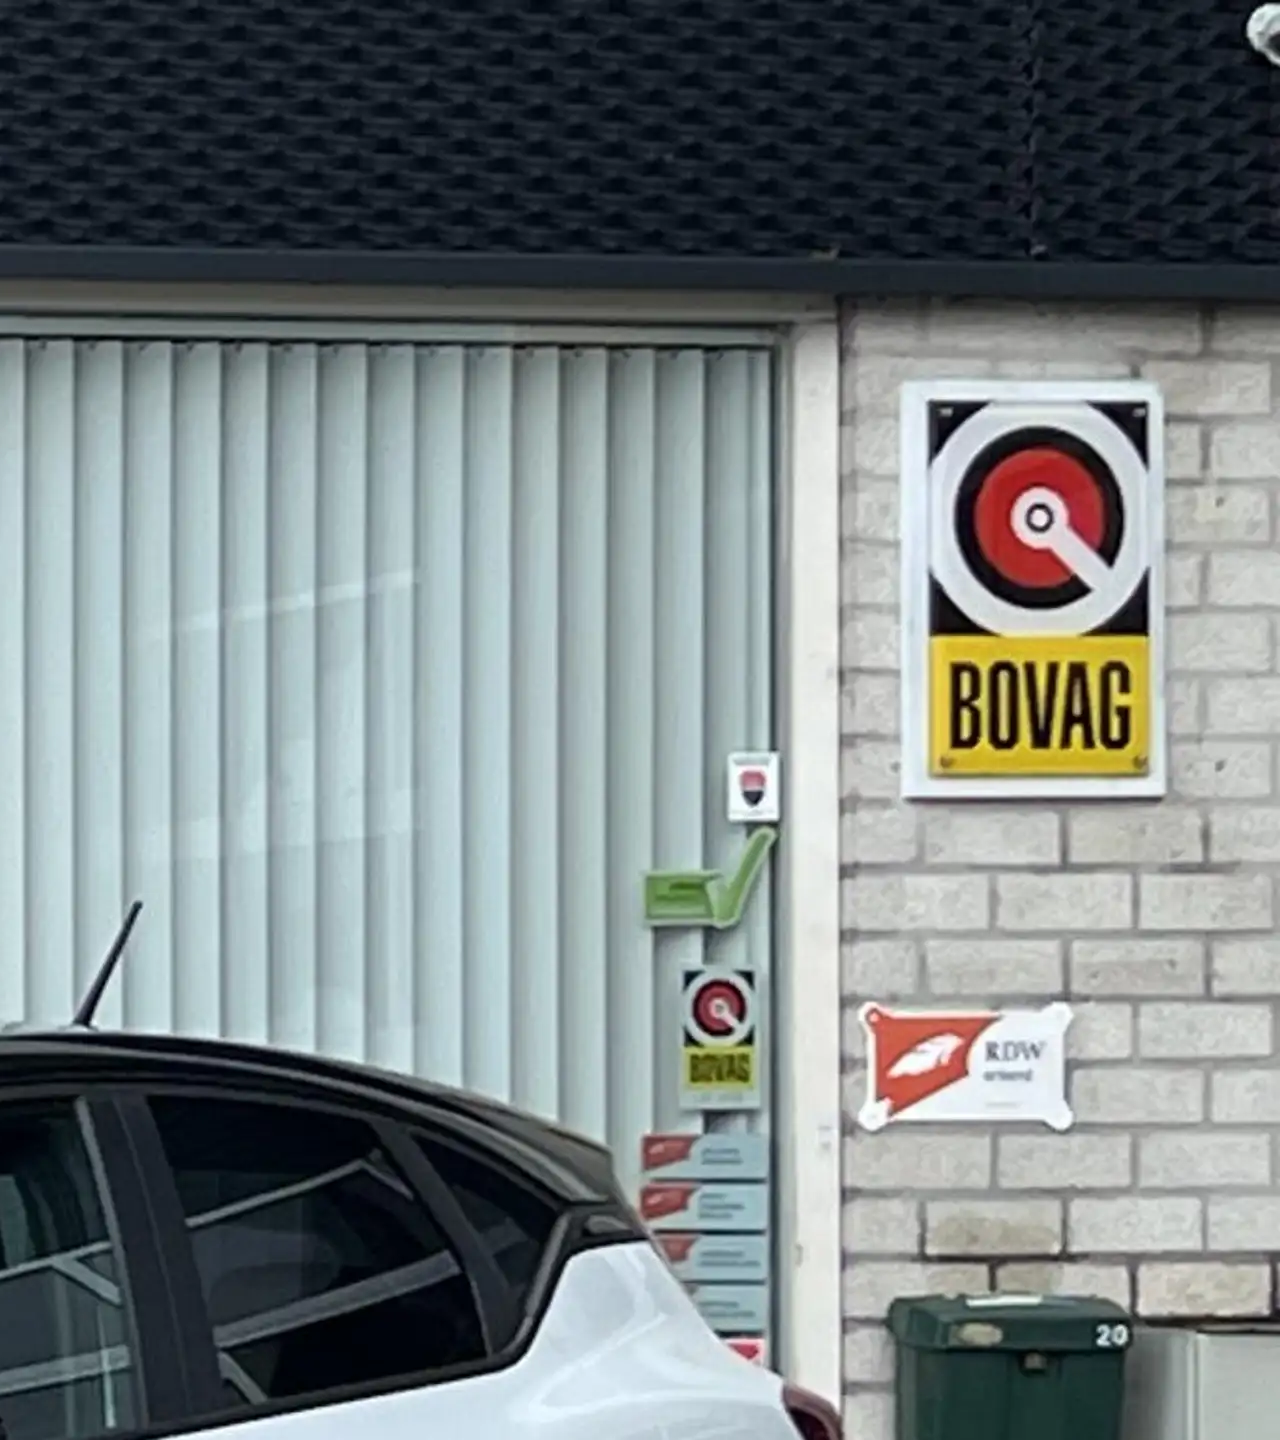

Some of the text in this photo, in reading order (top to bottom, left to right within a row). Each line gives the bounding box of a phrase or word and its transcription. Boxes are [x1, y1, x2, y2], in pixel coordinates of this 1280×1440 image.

[950, 660, 1131, 750] BOVAG
[985, 1040, 1047, 1061] RDW
[1096, 1323, 1130, 1348] 20
